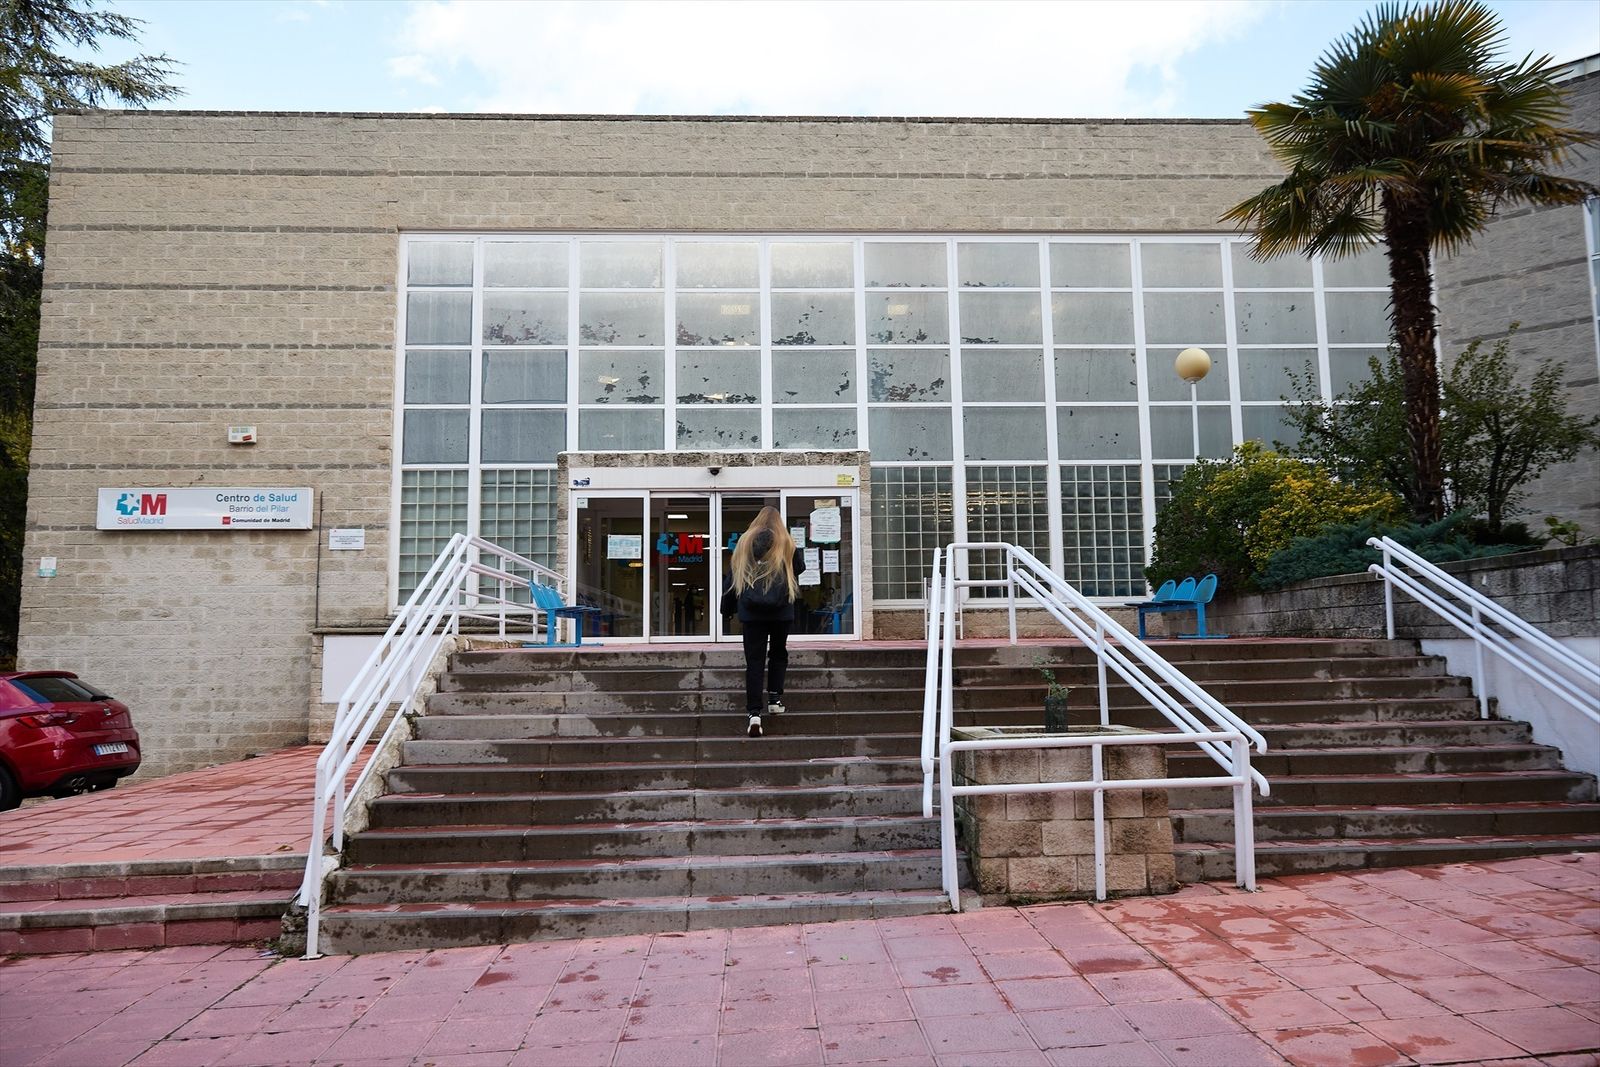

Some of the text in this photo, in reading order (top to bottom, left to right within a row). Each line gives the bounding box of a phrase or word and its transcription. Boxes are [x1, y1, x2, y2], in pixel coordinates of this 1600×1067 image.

[216, 493, 297, 502] Centro de Salud
[141, 494, 167, 515] M
[229, 505, 254, 513] Barrio
[256, 505, 268, 513] del
[116, 517, 164, 525] SaludMadrid
[678, 533, 703, 554] M
